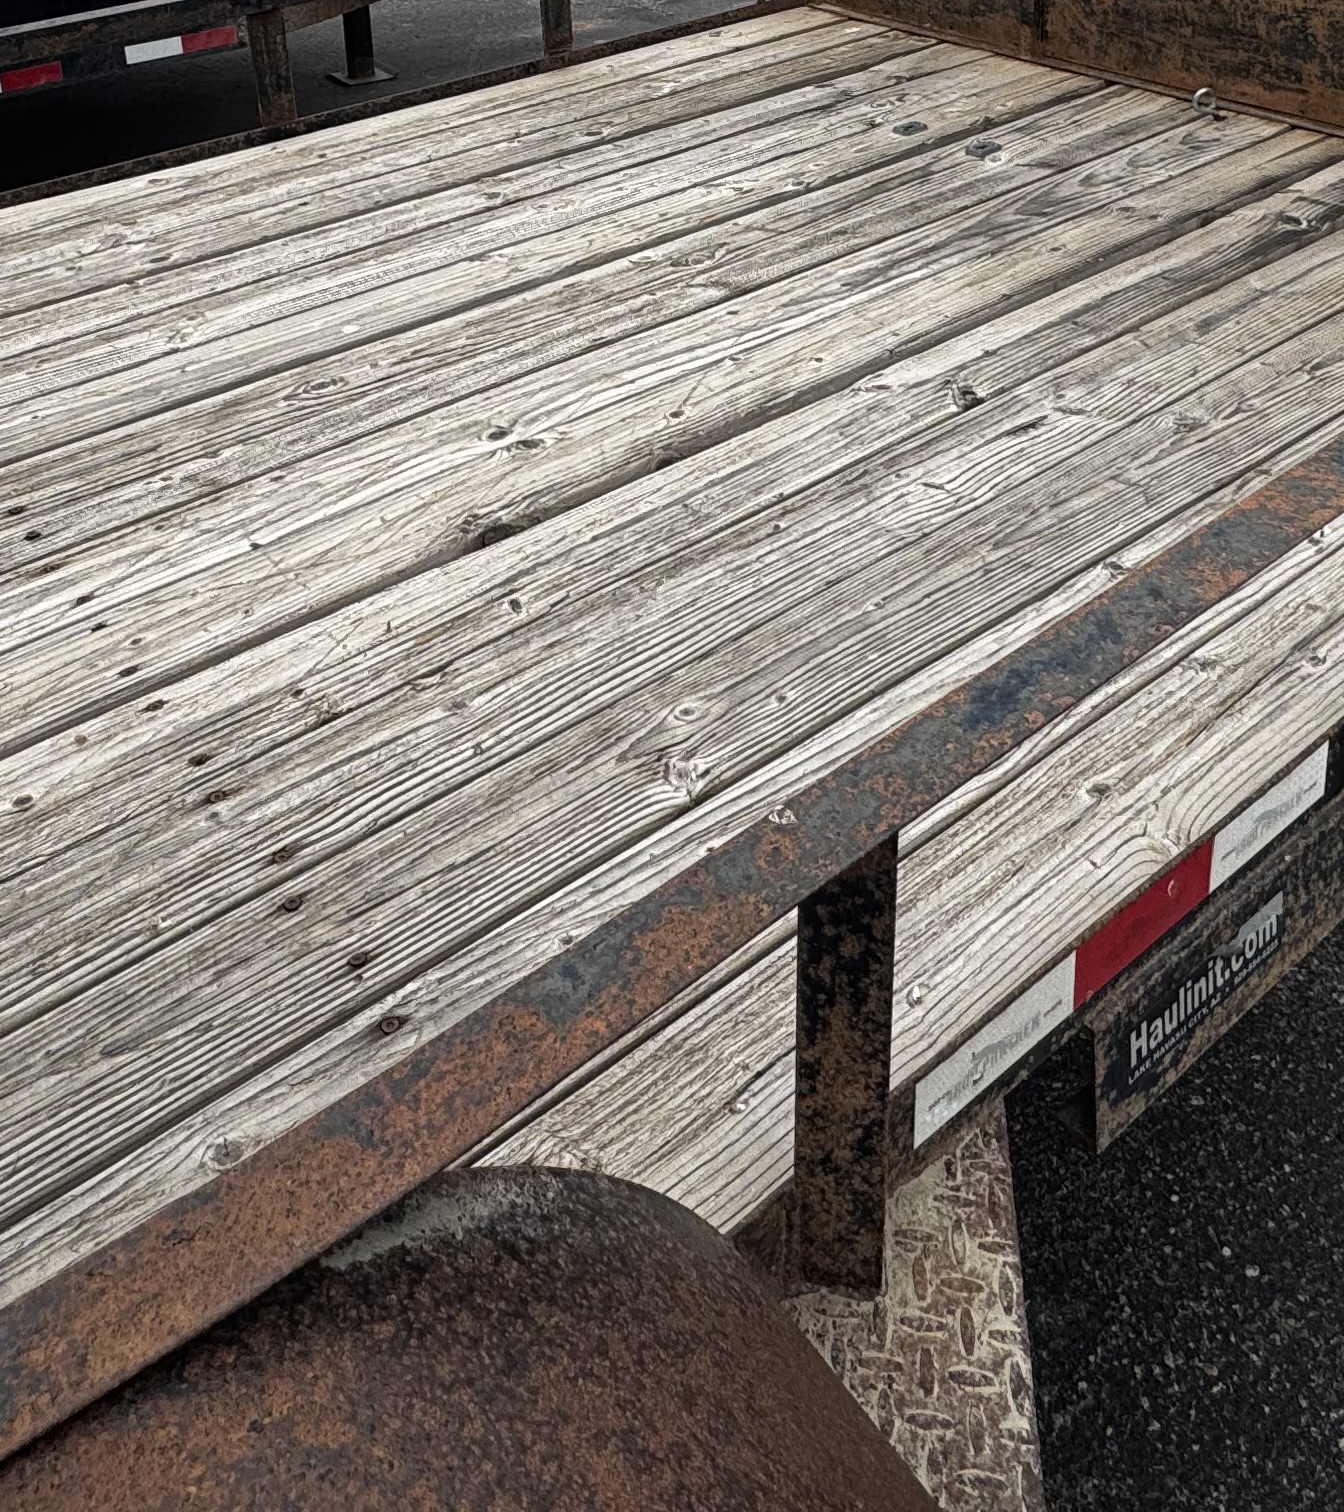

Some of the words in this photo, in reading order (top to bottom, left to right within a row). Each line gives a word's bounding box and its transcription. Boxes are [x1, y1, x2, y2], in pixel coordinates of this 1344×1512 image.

[1130, 914, 1278, 1069] Haulinit.com
[1128, 1059, 1152, 1085] LAKE
[1153, 1024, 1188, 1063] HAVASU
